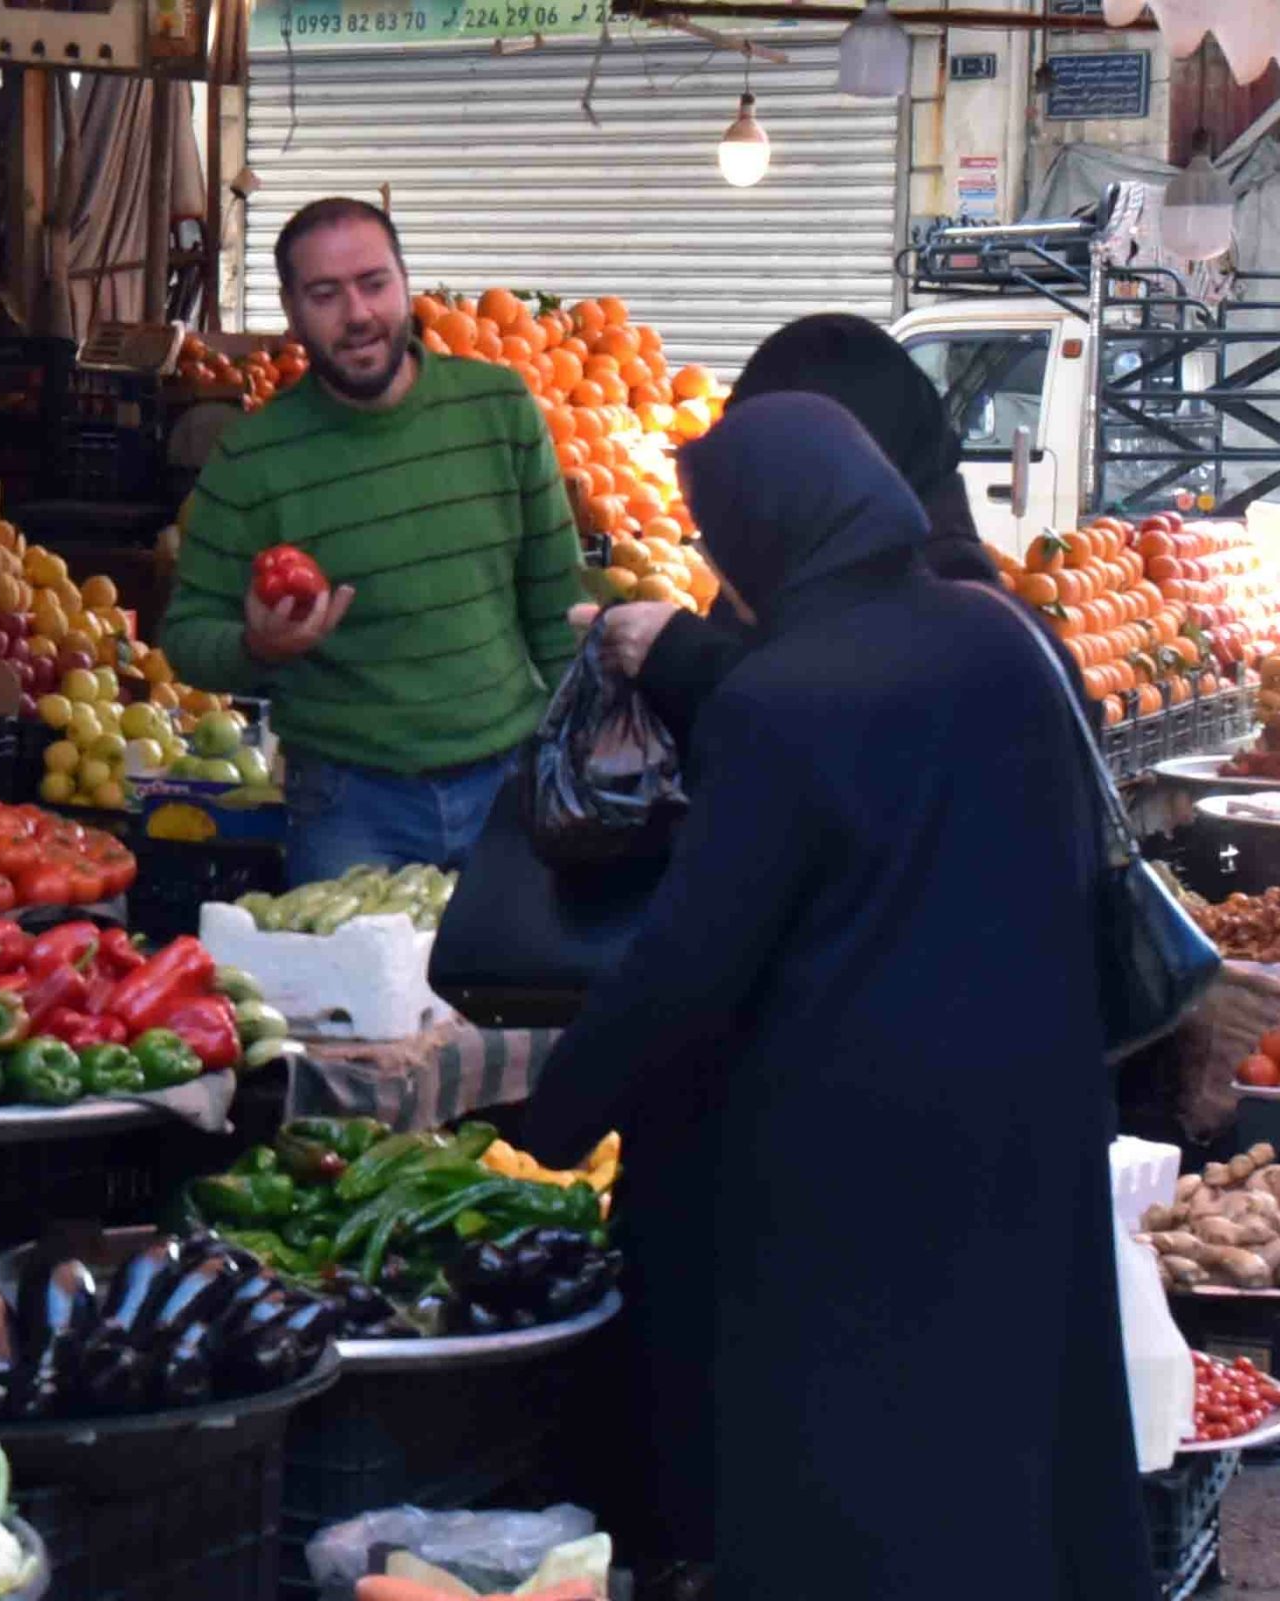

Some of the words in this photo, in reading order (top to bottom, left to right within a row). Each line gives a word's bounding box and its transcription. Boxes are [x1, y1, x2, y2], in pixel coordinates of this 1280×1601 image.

[297, 14, 341, 35] 0993
[347, 13, 370, 33] 82
[403, 11, 426, 30] 70
[465, 9, 500, 28] 224
[535, 5, 559, 25] 06
